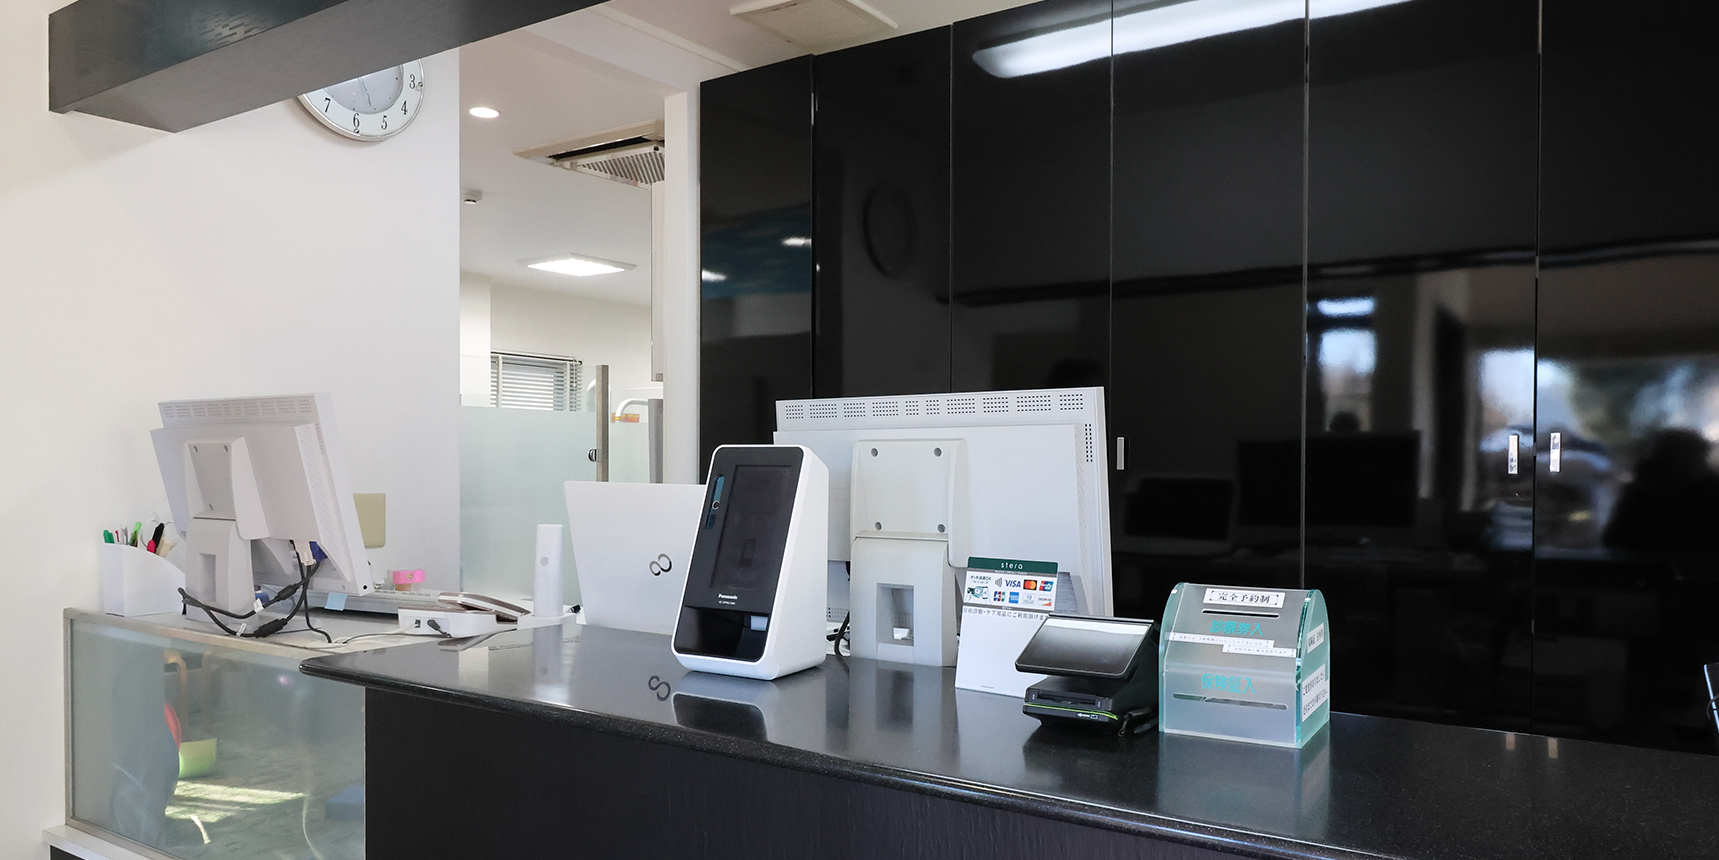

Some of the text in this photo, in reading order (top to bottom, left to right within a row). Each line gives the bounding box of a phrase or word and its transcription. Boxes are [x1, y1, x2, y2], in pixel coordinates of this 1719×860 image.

[409, 74, 416, 89] 3
[324, 97, 331, 113] 7
[401, 100, 408, 115] 4
[353, 113, 360, 128] 6
[381, 115, 388, 130] 5
[1000, 562, 1023, 570] stera
[1005, 579, 1021, 588] VISA
[1219, 592, 1270, 604] 完全予約制
[1209, 620, 1264, 637] 診察券入
[1201, 673, 1257, 695] 保険証入
